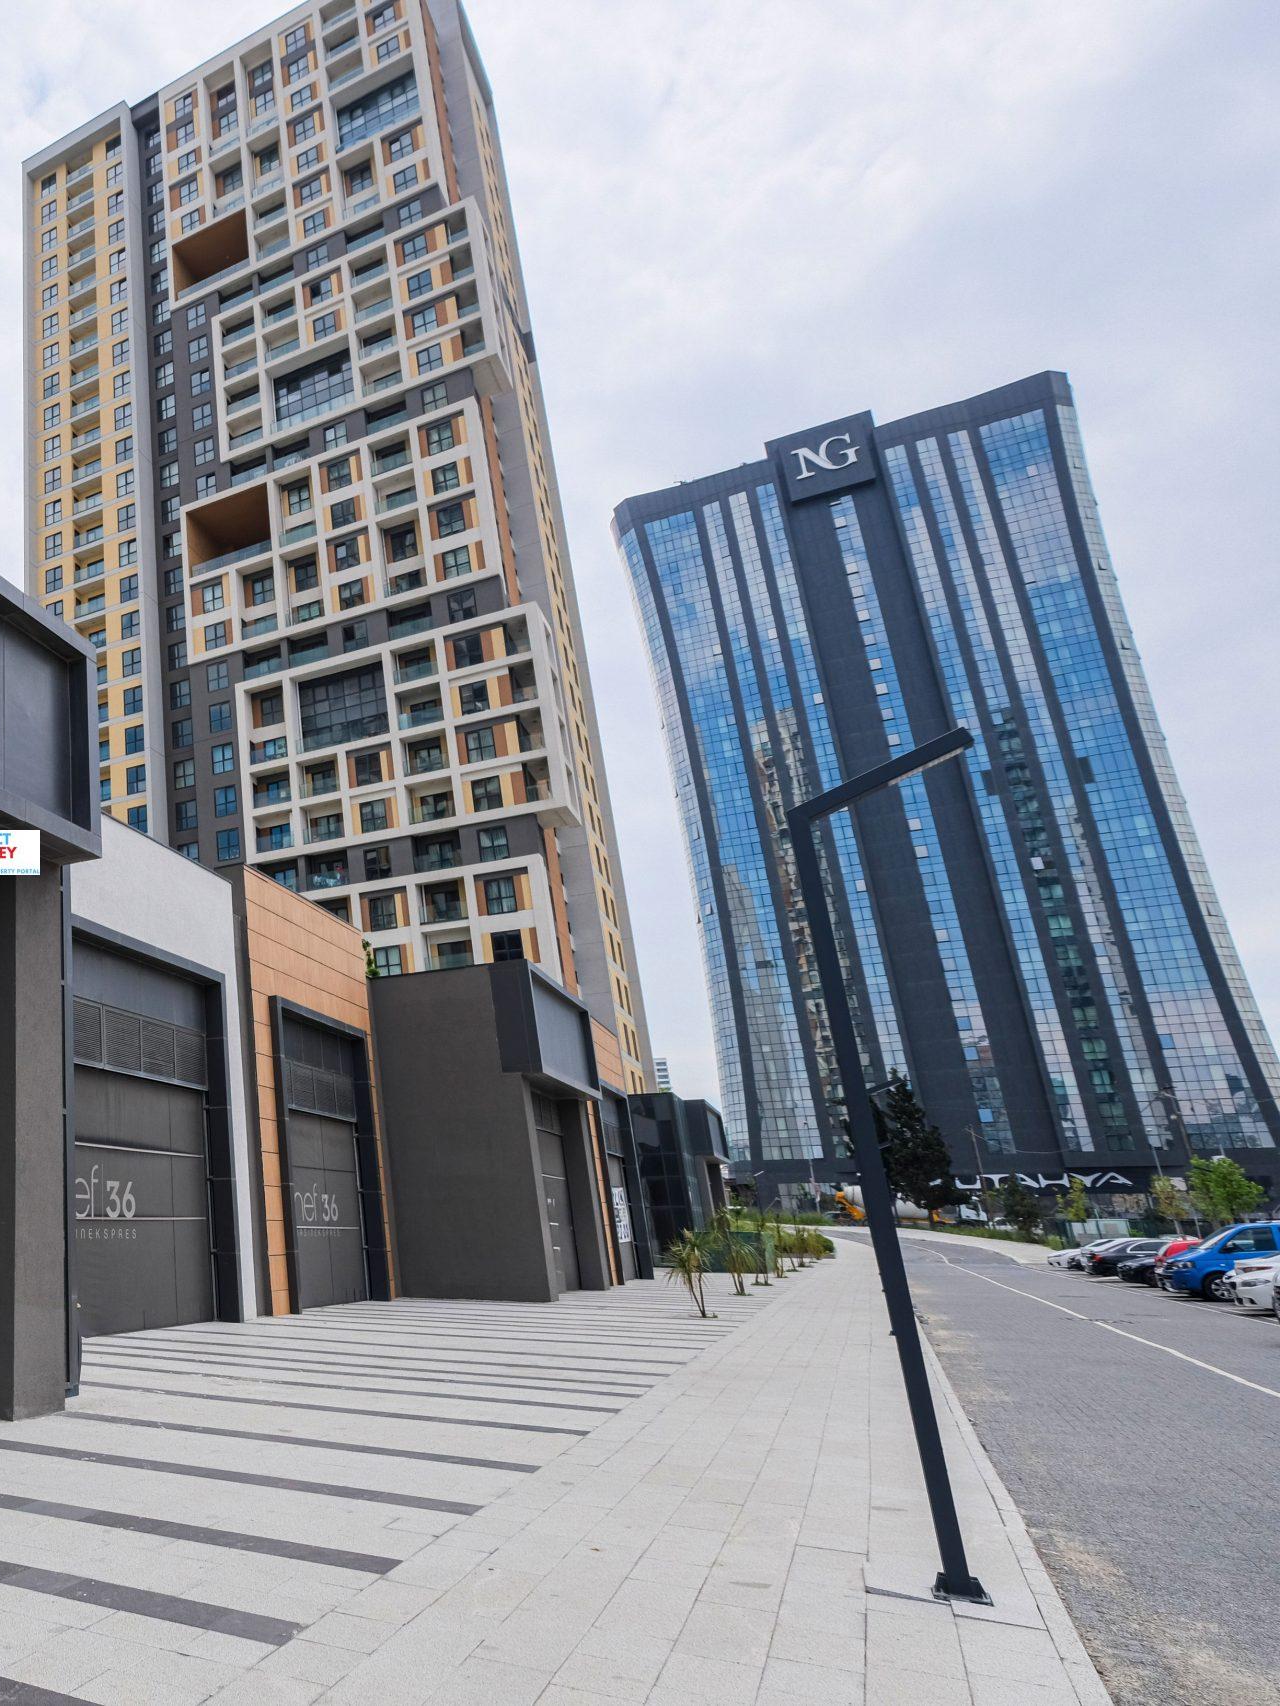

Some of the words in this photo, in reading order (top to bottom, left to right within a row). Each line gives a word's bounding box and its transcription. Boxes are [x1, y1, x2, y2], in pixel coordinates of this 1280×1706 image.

[790, 433, 860, 479] NG
[106, 1181, 136, 1218] 36
[294, 1183, 317, 1221] nef
[321, 1194, 339, 1221] 36
